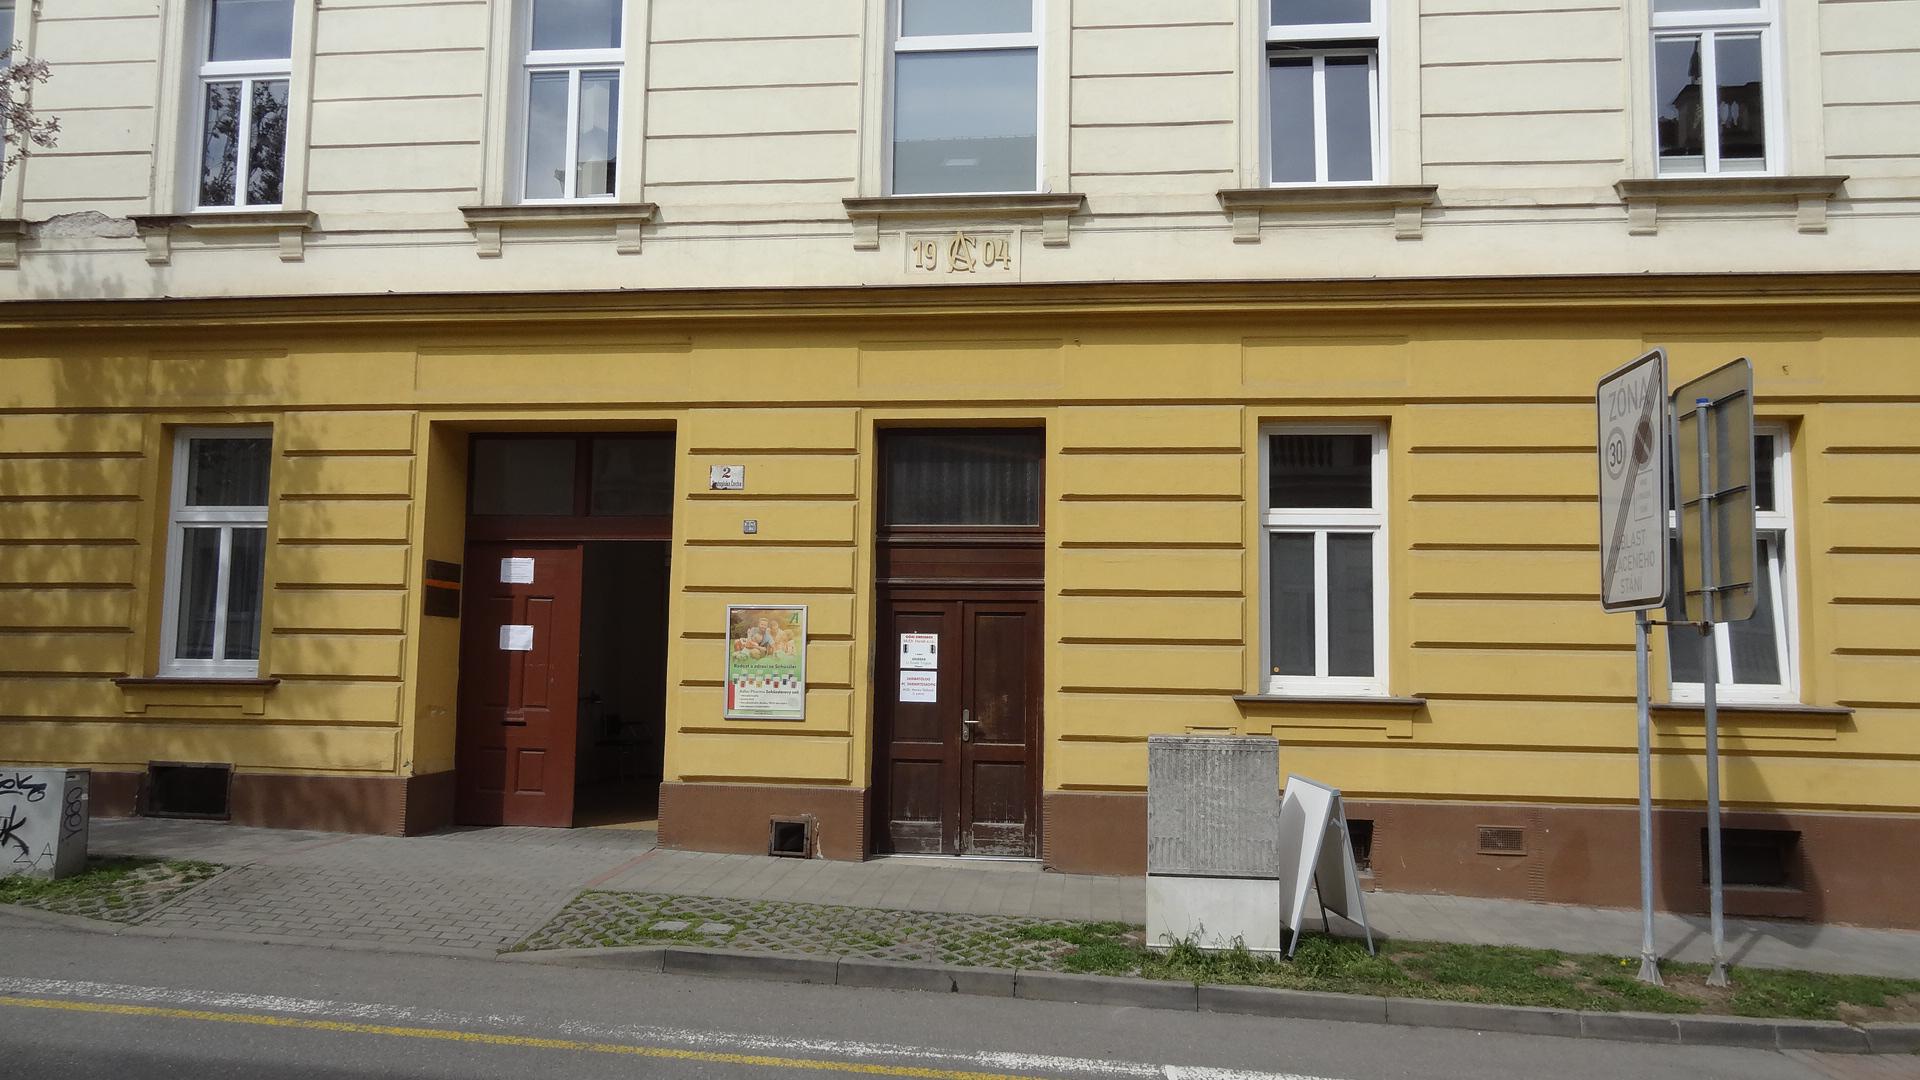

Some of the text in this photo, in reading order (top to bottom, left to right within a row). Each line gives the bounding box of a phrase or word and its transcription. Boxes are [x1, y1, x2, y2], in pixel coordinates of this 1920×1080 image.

[912, 239, 938, 271] 19
[982, 239, 1012, 271] 04
[1607, 376, 1649, 423] ZÓNA
[1609, 439, 1623, 468] 30
[722, 467, 731, 479] 2
